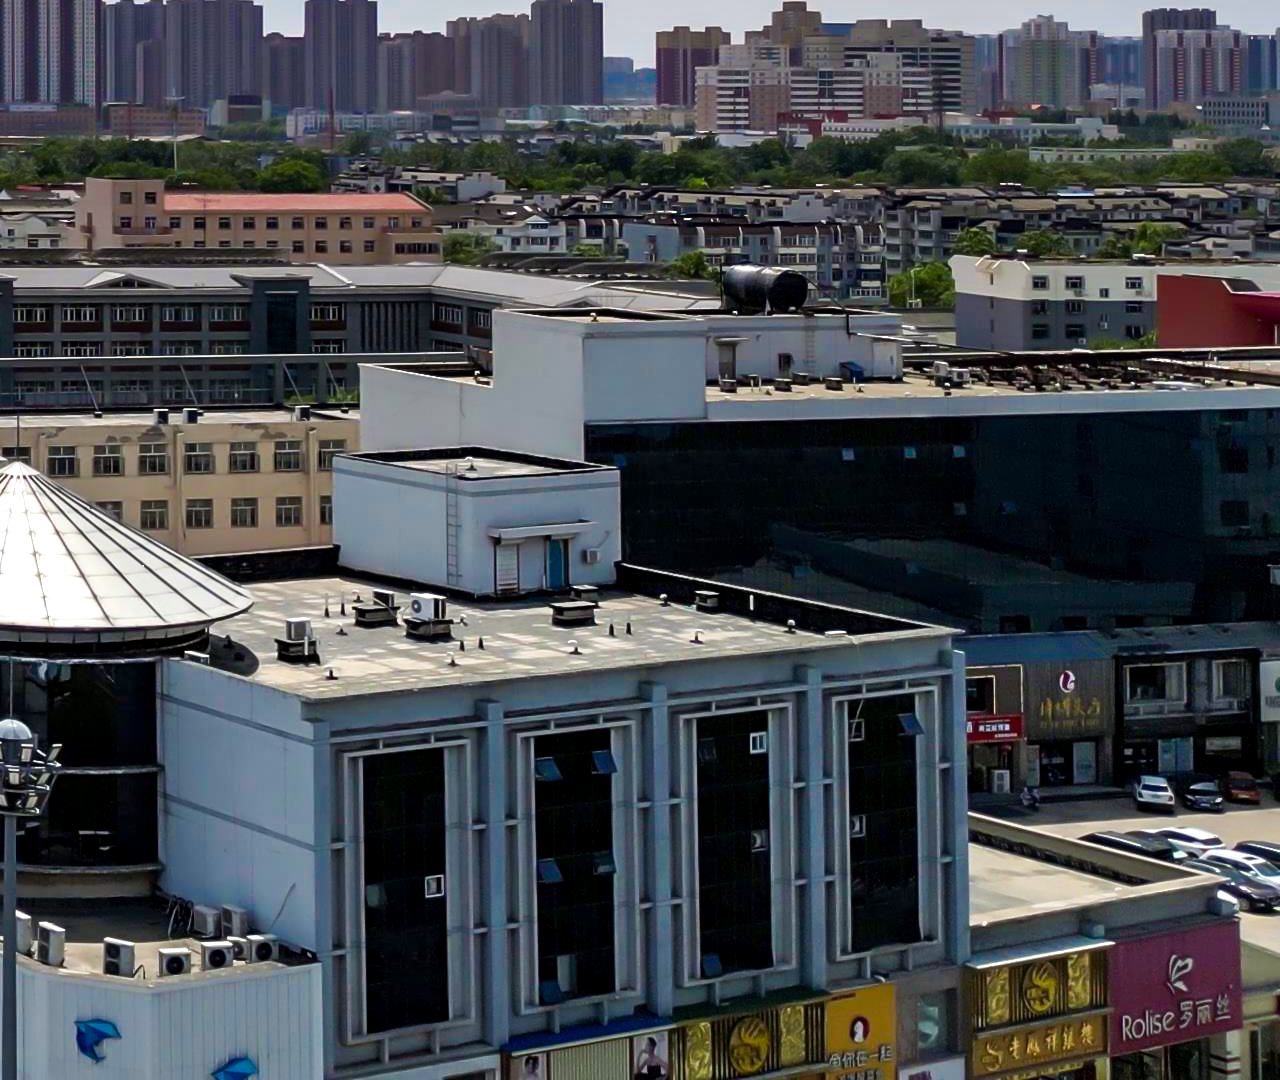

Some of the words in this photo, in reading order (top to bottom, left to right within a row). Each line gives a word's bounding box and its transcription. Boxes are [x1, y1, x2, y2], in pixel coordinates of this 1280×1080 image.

[1122, 1010, 1175, 1041] Rolise
[1180, 993, 1232, 1029] 罗丽丝
